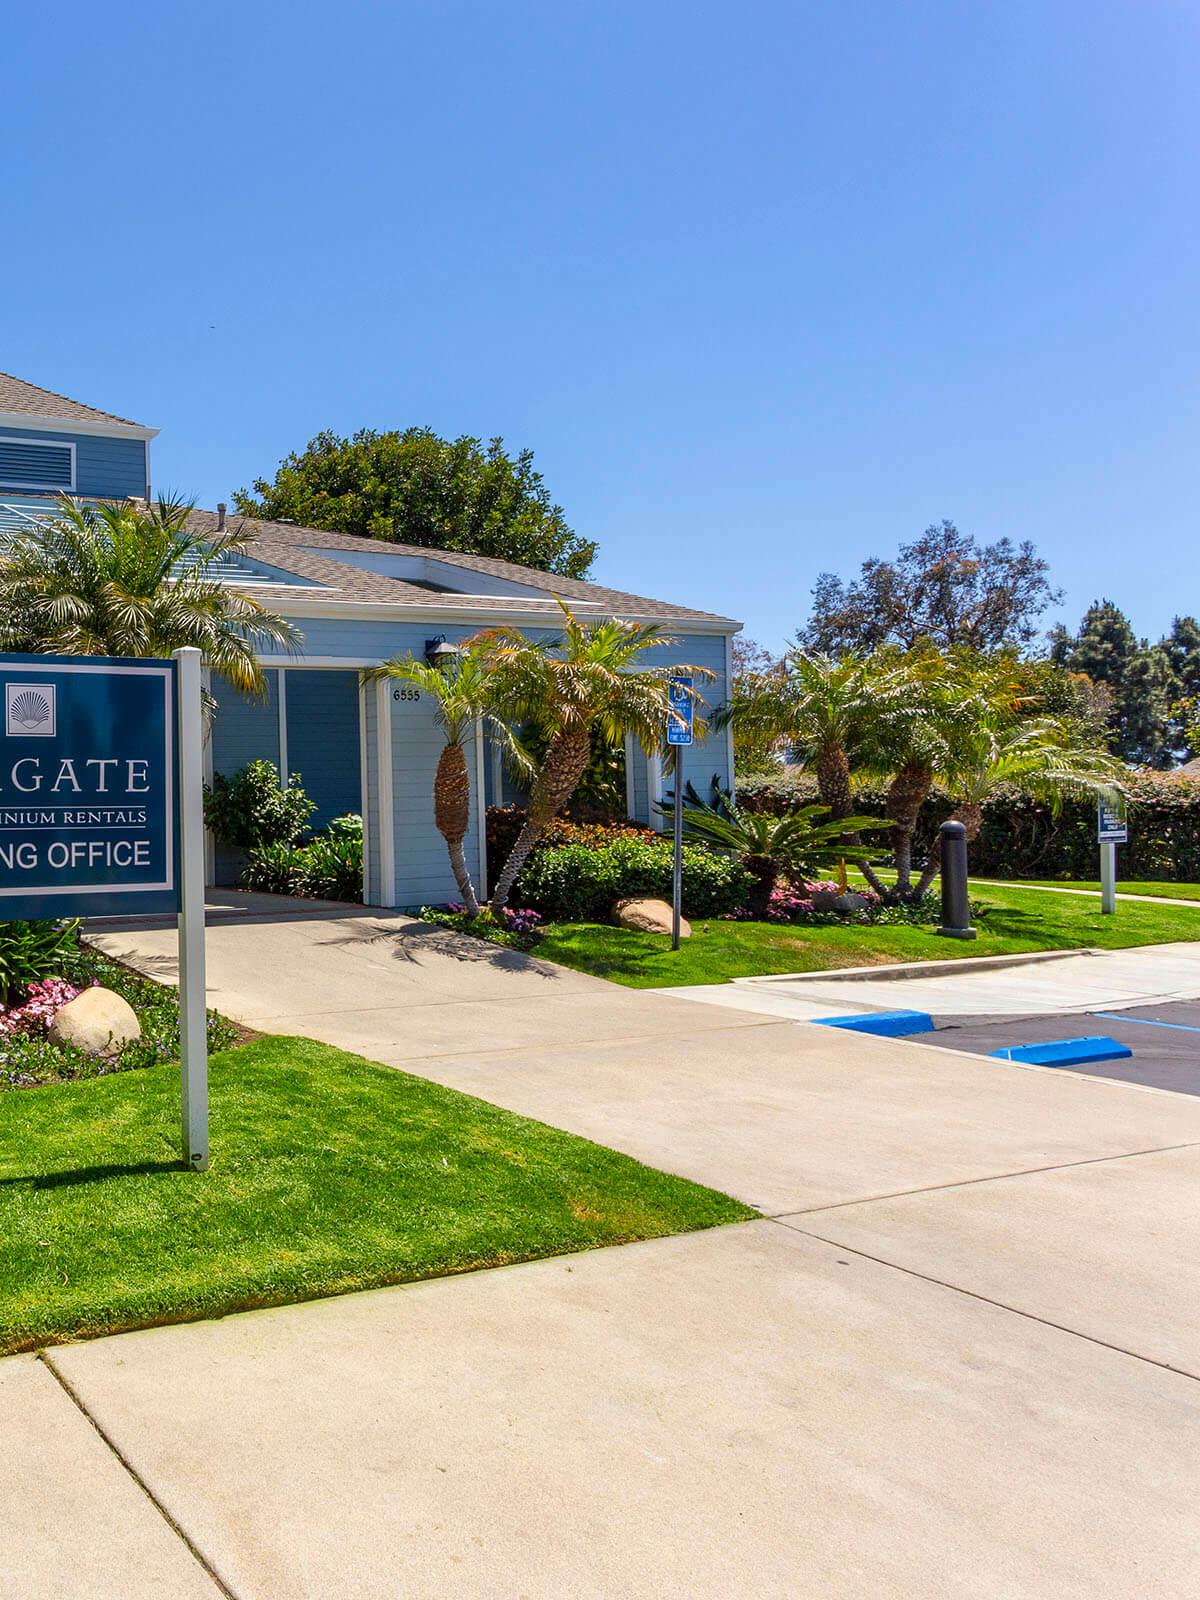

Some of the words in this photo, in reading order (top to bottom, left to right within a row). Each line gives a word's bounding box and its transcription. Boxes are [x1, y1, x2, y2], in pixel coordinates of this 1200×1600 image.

[393, 689, 421, 702] 6555
[63, 811, 147, 824] RENTALS
[47, 840, 151, 868] OFFICE
